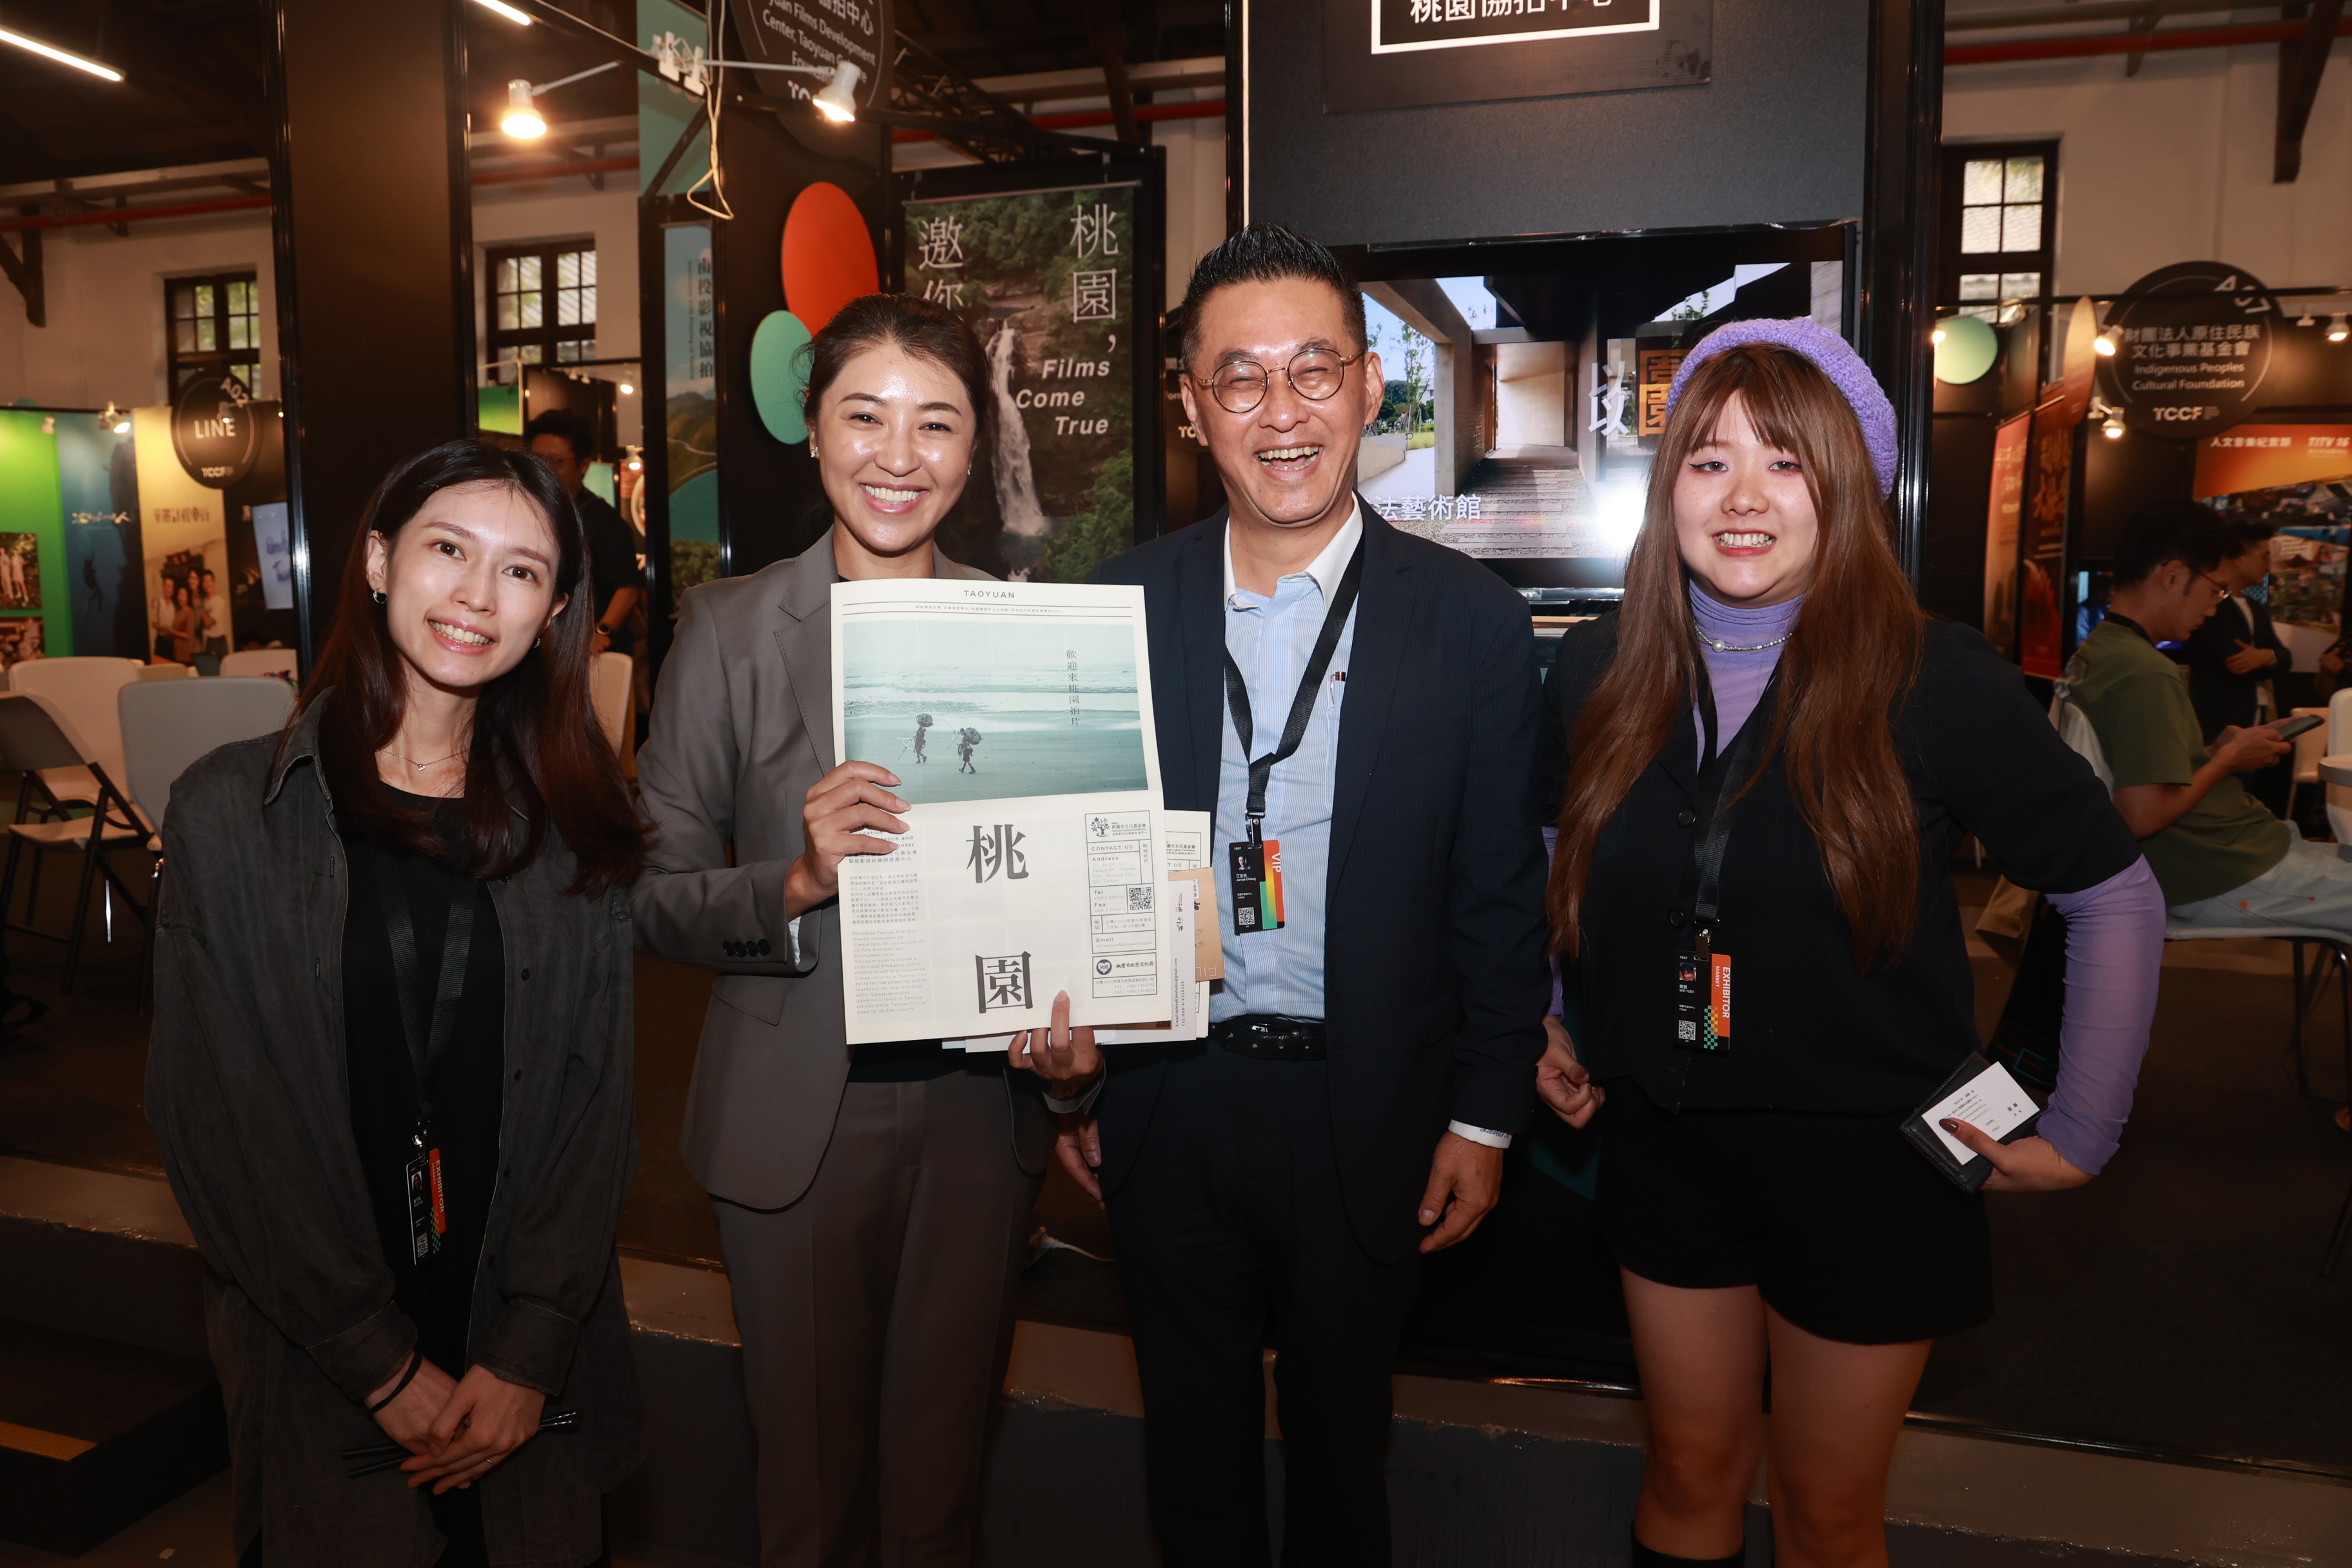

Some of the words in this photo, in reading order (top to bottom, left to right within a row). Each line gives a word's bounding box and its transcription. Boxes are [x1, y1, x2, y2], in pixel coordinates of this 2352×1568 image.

[763, 9, 796, 43] Center,
[798, 29, 836, 64] Taoyuan
[794, 2, 818, 30] Films
[819, 19, 876, 66] Development
[2124, 324, 2260, 342] 財團法人原住民族
[2132, 341, 2250, 358] 文化事業基金會
[1042, 358, 1110, 379] Films
[2135, 364, 2197, 375] Indigenous
[2200, 362, 2245, 374] Peoples
[2132, 380, 2177, 391] Cultural
[2179, 378, 2245, 389] Foundation
[1015, 389, 1085, 409] Come
[2153, 407, 2202, 420] TCCF
[194, 419, 236, 438] LINE
[1054, 416, 1109, 435] True
[1365, 494, 1482, 520] 法藝術館
[963, 590, 1015, 598] TAOYUAN
[1066, 650, 1081, 726] 歡迎來桃園拍片
[1271, 852, 1282, 873] VIP
[1094, 920, 1099, 930] 地址
[1722, 966, 1731, 1019] EXHIBITOR
[436, 1159, 445, 1213] EXHIBITOR
